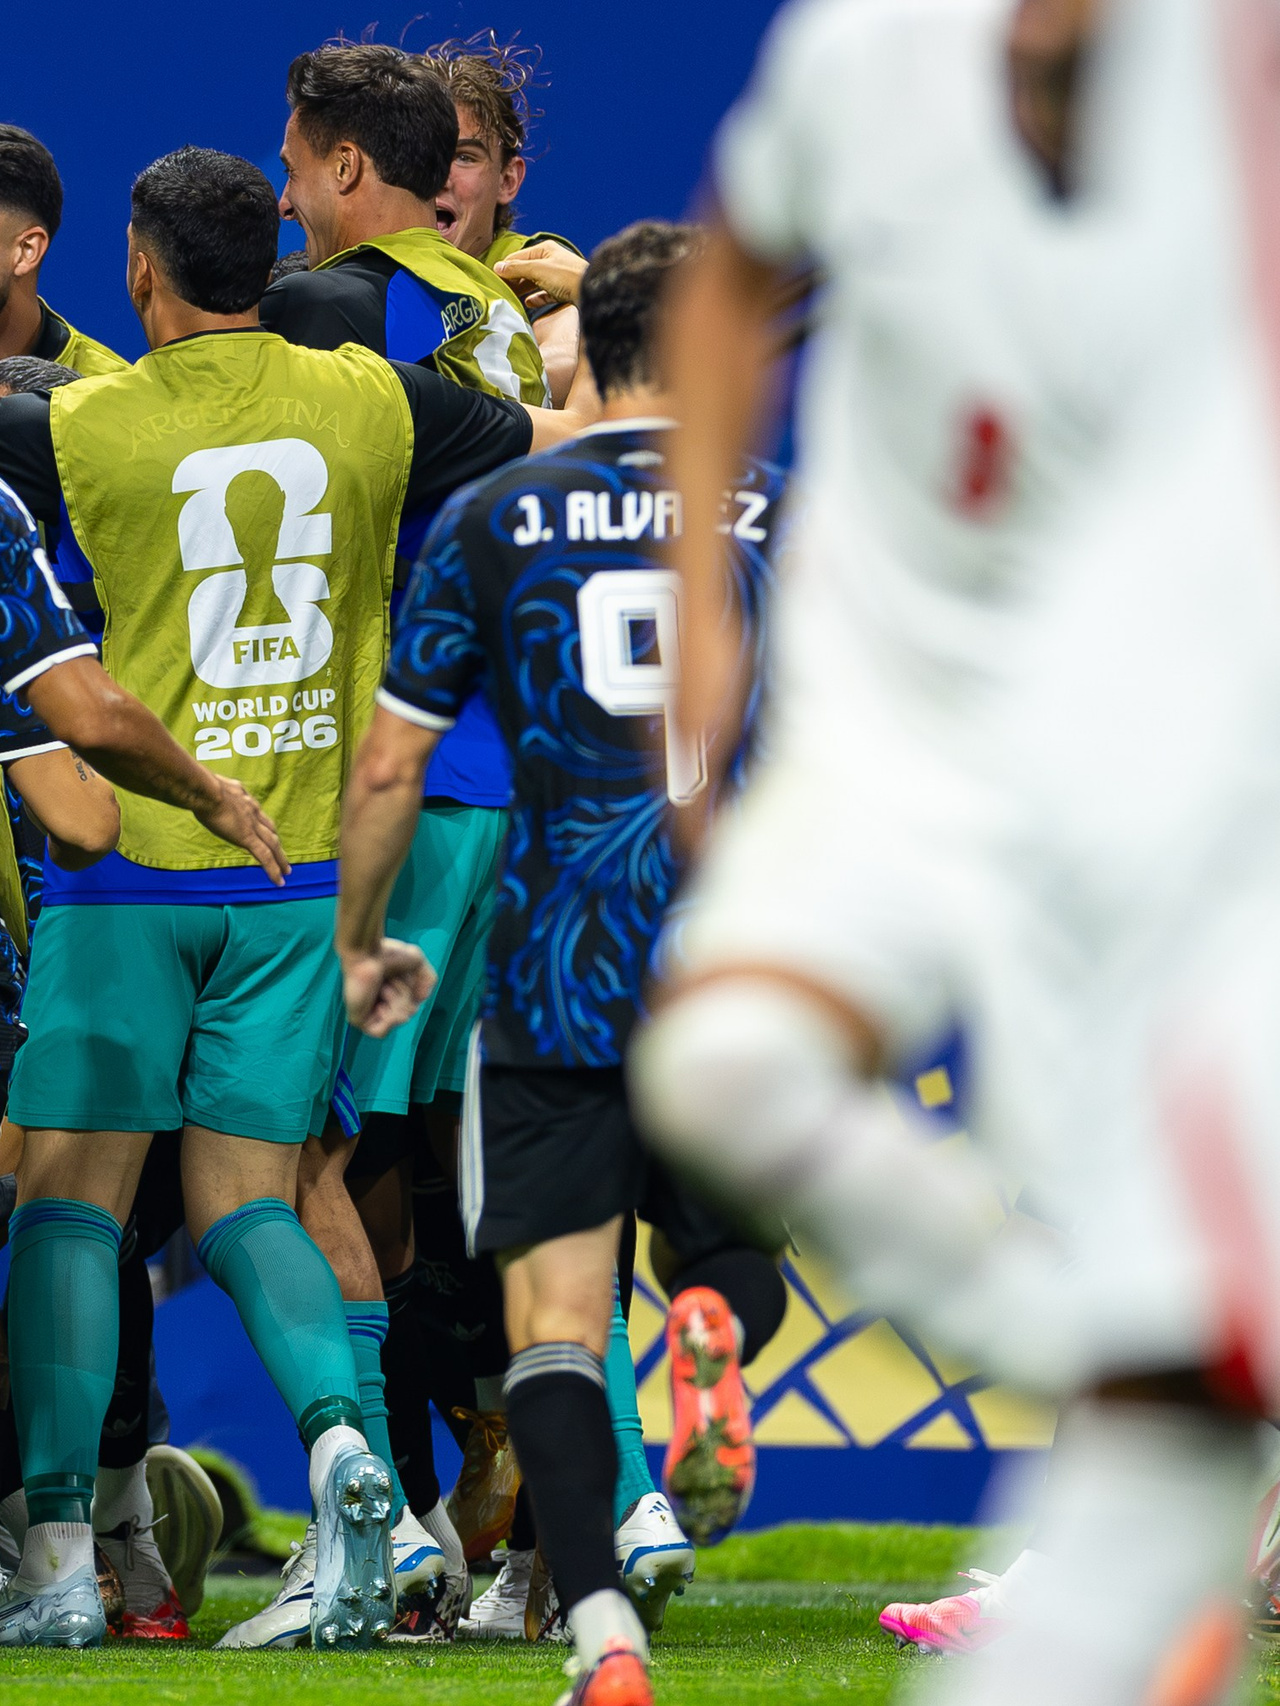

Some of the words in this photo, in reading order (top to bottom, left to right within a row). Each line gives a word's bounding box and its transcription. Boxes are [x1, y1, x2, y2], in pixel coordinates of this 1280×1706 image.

[513, 494, 554, 545] J.
[566, 490, 769, 543] ALVAZ
[232, 636, 302, 665] FIFA
[192, 696, 288, 722] WORLD
[292, 688, 336, 712] CUP
[576, 568, 708, 807] 9
[194, 715, 338, 761] 2026
